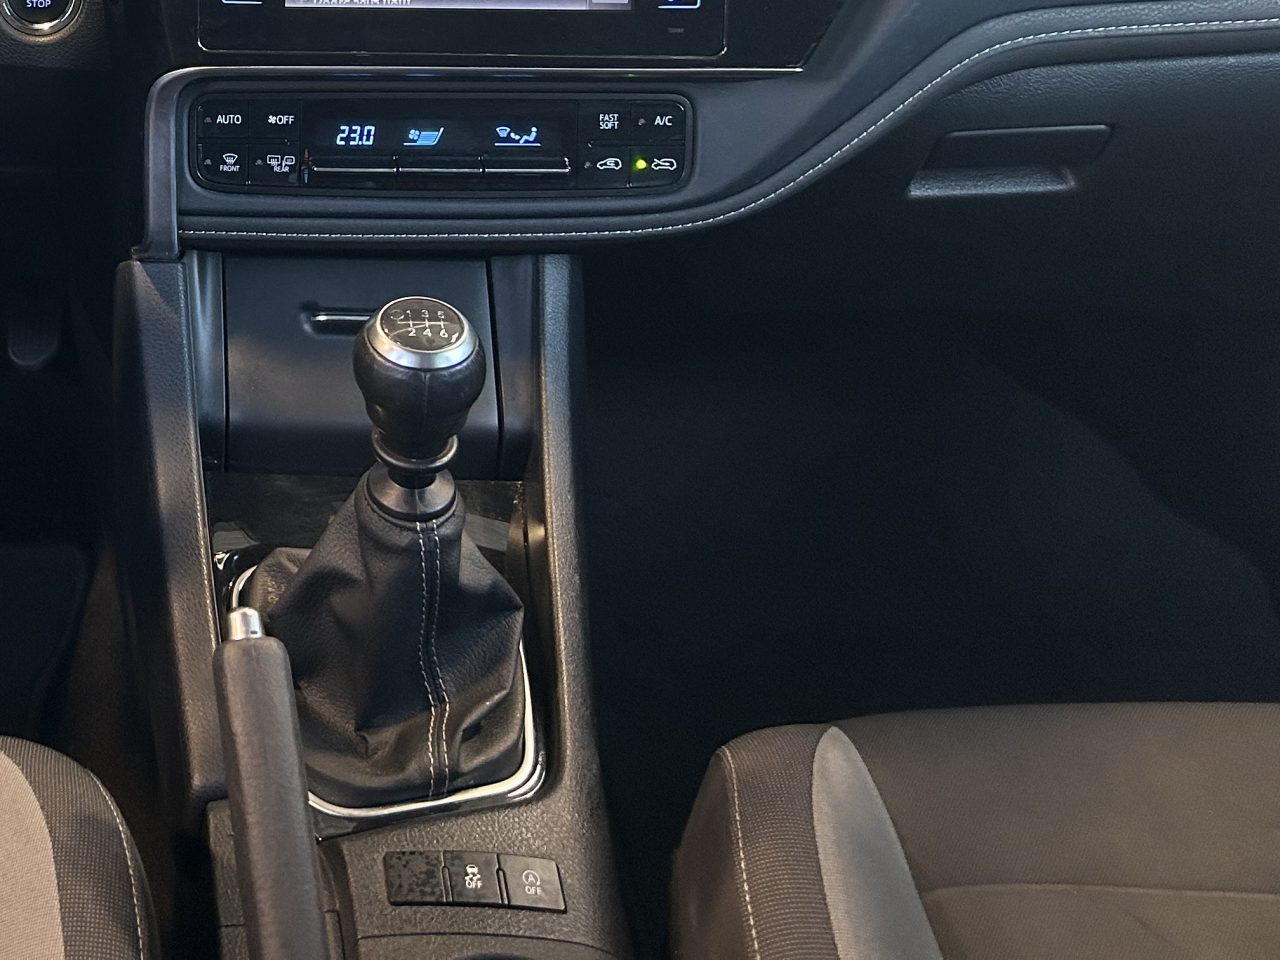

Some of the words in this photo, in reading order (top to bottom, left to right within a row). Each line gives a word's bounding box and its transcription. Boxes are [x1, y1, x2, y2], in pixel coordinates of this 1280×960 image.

[26, 0, 51, 8] STOP
[216, 115, 242, 125] AUTO
[276, 115, 295, 125] OFF
[599, 113, 619, 121] FAST
[654, 116, 673, 126] A/C
[336, 125, 376, 146] 23.0
[408, 328, 417, 337] 2
[423, 328, 432, 337] 4
[439, 329, 448, 338] 6
[465, 880, 483, 889] OFF
[525, 886, 542, 895] OFF
